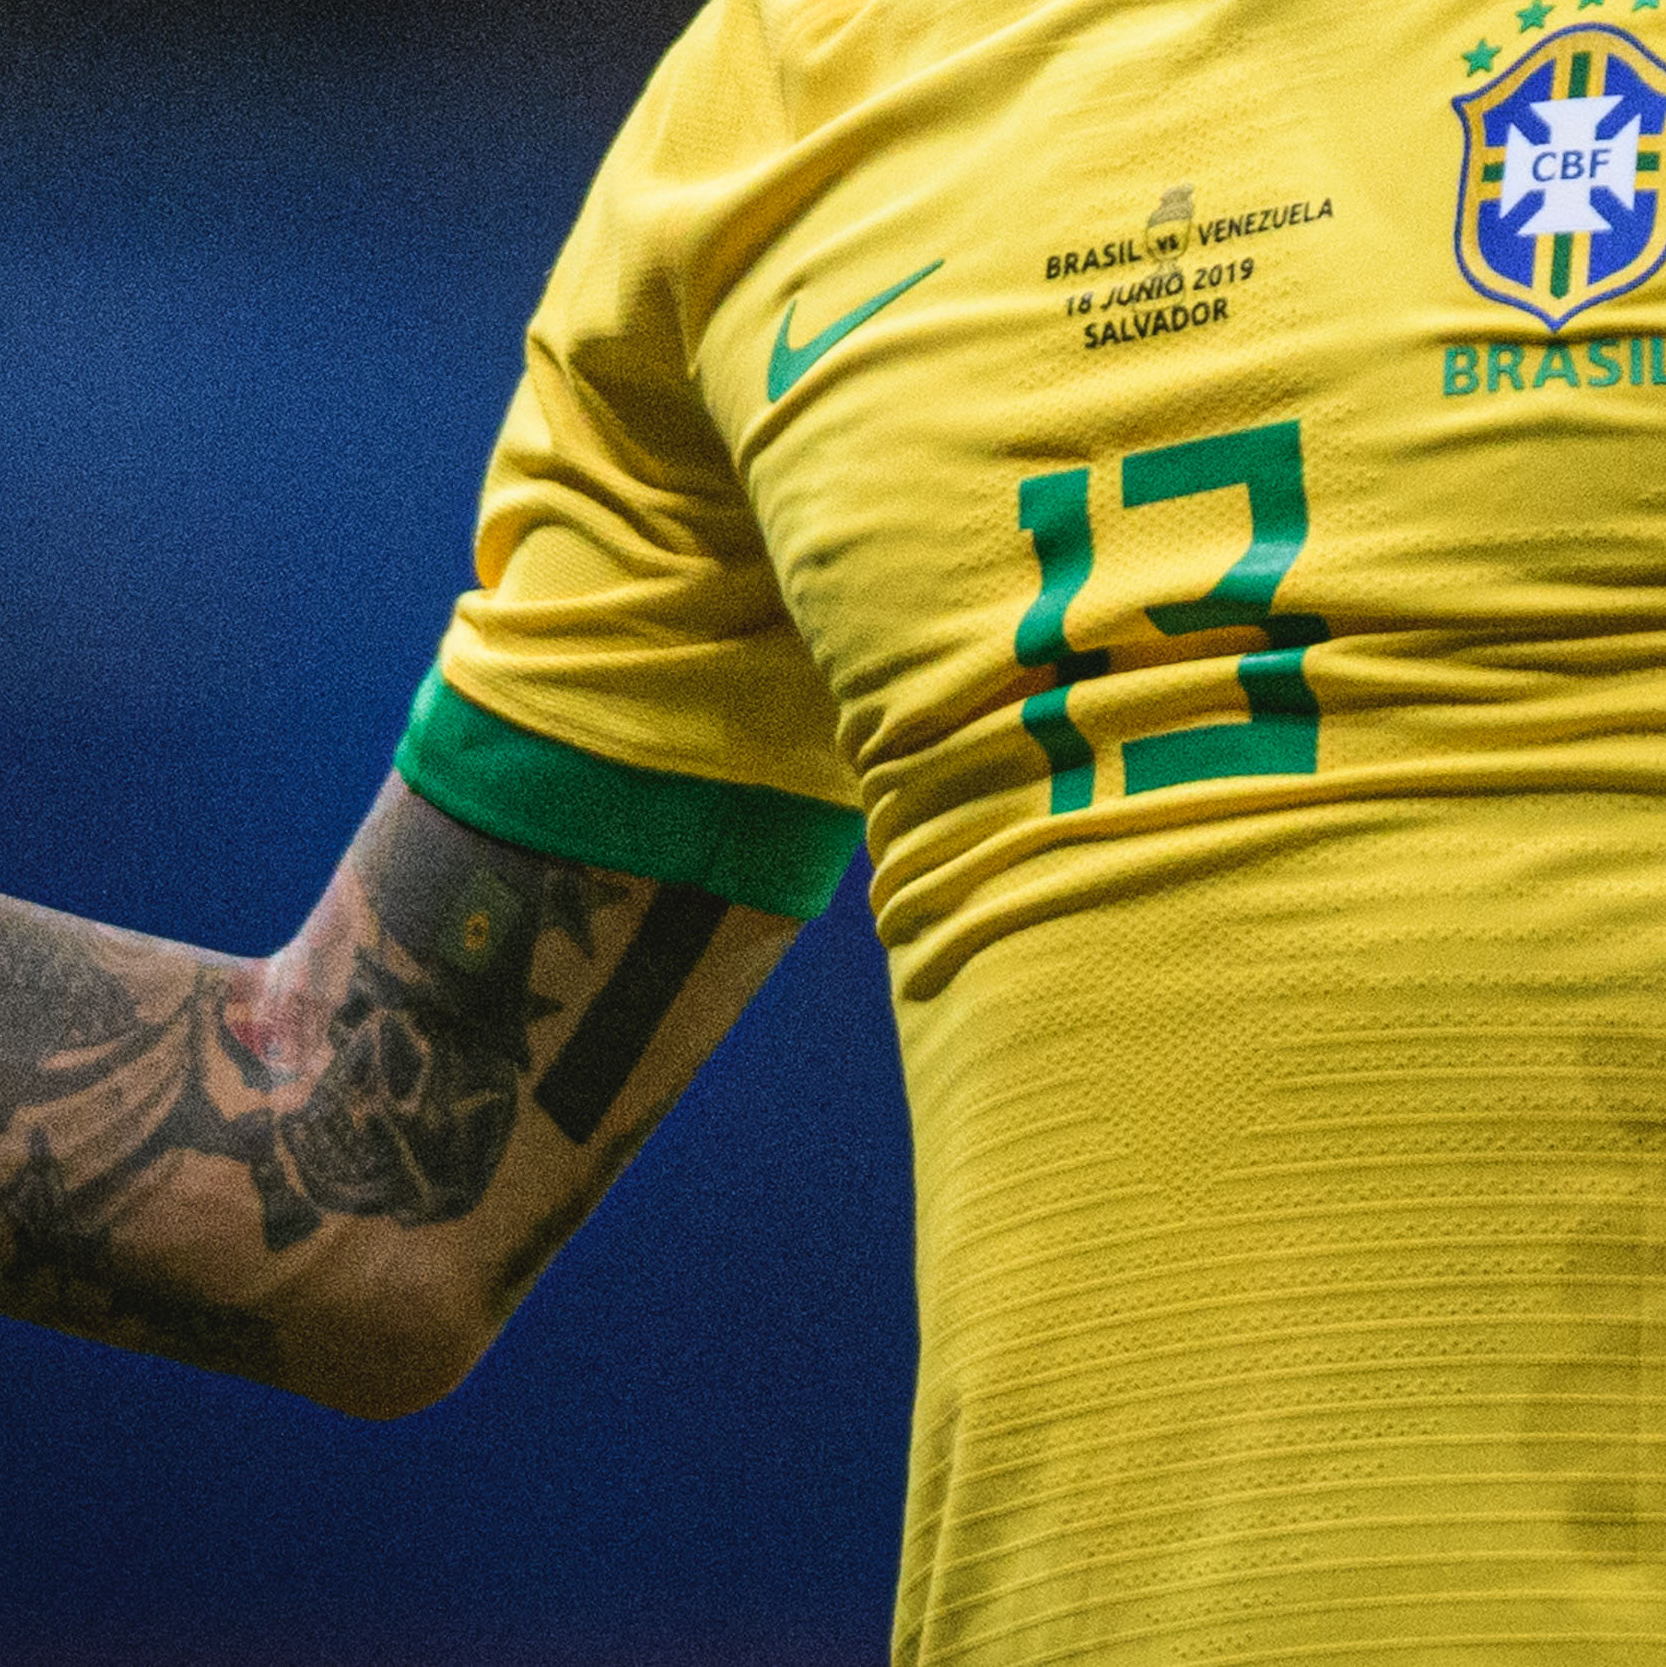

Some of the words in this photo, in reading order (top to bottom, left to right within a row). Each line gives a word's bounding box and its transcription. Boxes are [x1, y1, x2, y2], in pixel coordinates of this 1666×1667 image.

[1532, 148, 1612, 182] CBF
[1046, 240, 1142, 279] BRASIL
[1197, 197, 1333, 246] VENEZUELA
[1099, 272, 1183, 310] JUNIO
[1193, 257, 1255, 291] 2019
[1083, 296, 1229, 349] SALVADOR
[1015, 419, 1332, 816] 13
